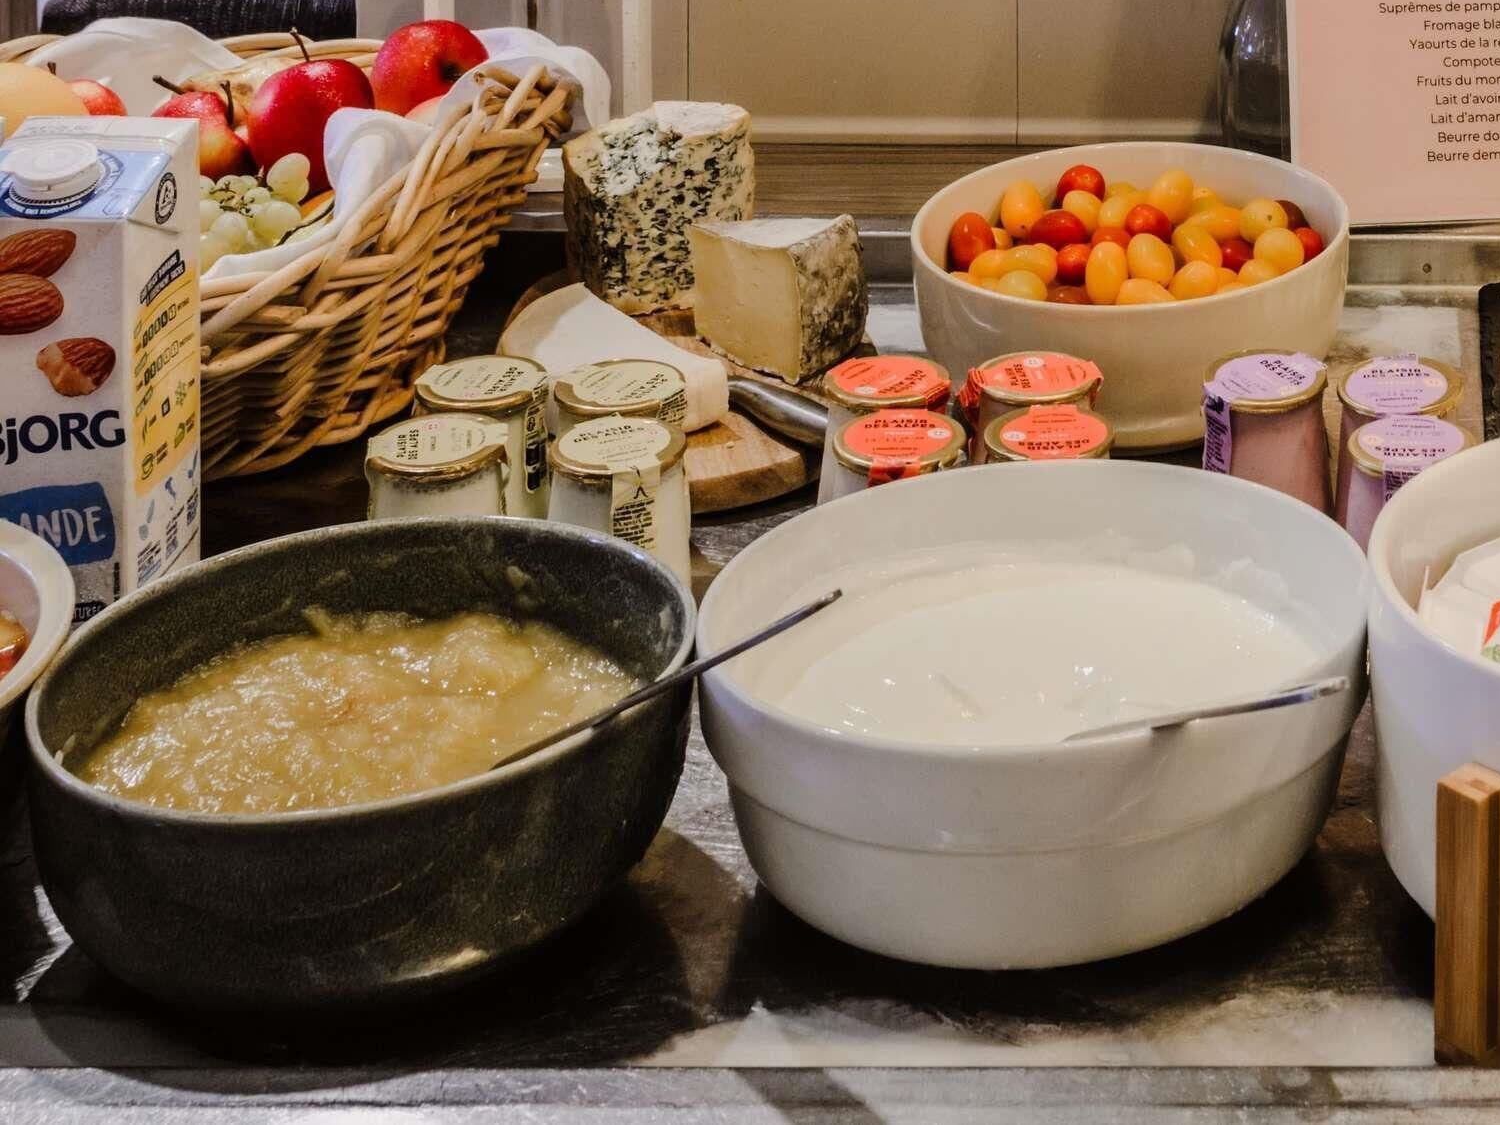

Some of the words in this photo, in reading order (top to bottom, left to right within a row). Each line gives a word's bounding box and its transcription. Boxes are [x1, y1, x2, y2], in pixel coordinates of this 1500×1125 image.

[1378, 1, 1442, 15] Suprêmes
[1445, 0, 1461, 12] de
[1423, 20, 1480, 33] Fromage
[1409, 39, 1457, 50] Yaourts
[1460, 37, 1476, 49] de
[1479, 37, 1489, 48] la
[1416, 75, 1453, 87] Fruits
[1455, 74, 1472, 86] du
[1435, 94, 1458, 105] Lait
[1431, 113, 1453, 124] Lait
[1438, 131, 1480, 143] Beurre
[1427, 150, 1470, 163] Beurre
[0, 409, 126, 465] jORG
[16, 506, 106, 548] ANDE
